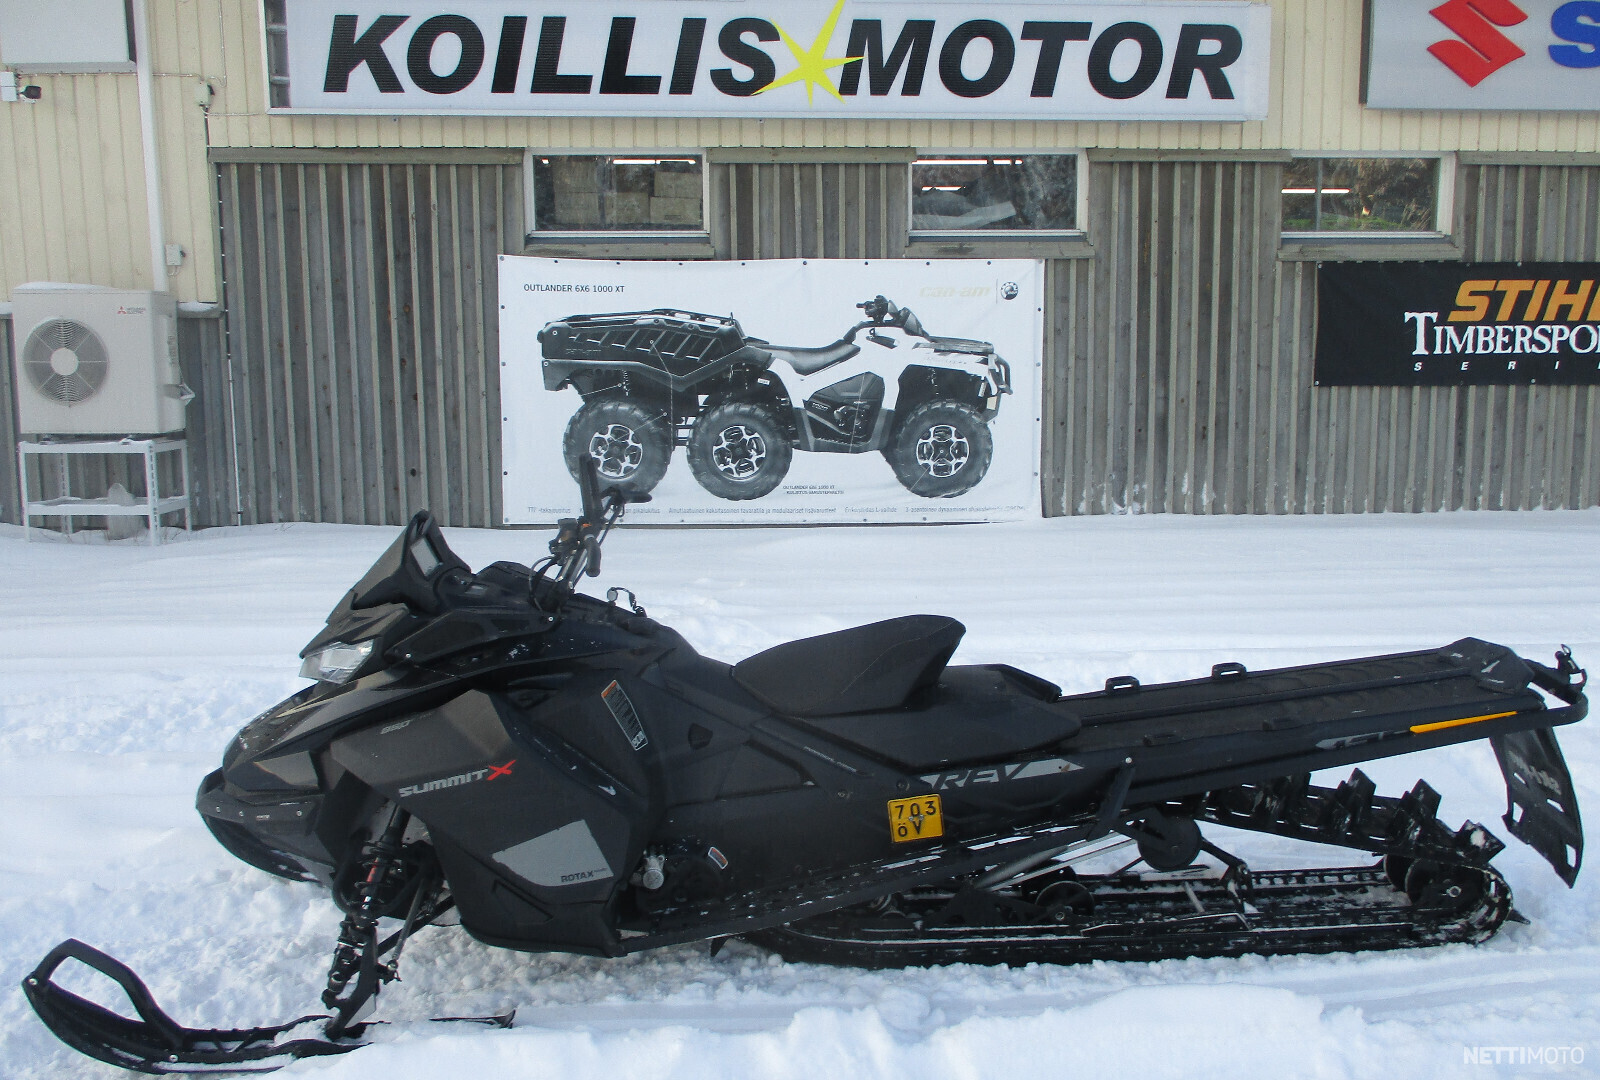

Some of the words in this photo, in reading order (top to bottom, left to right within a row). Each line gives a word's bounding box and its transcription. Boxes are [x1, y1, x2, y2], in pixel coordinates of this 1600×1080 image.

[323, 14, 781, 97] KOILLIS
[838, 19, 1243, 100] MOTOR
[523, 283, 573, 292] OUTLANDER
[574, 284, 590, 293] 6X6
[592, 285, 614, 293] 1000
[615, 285, 626, 293] XT
[1404, 310, 1600, 355] TIMBERSPO
[1413, 360, 1600, 371] SERI
[895, 801, 937, 819] 703
[560, 870, 594, 883] ROTAX
